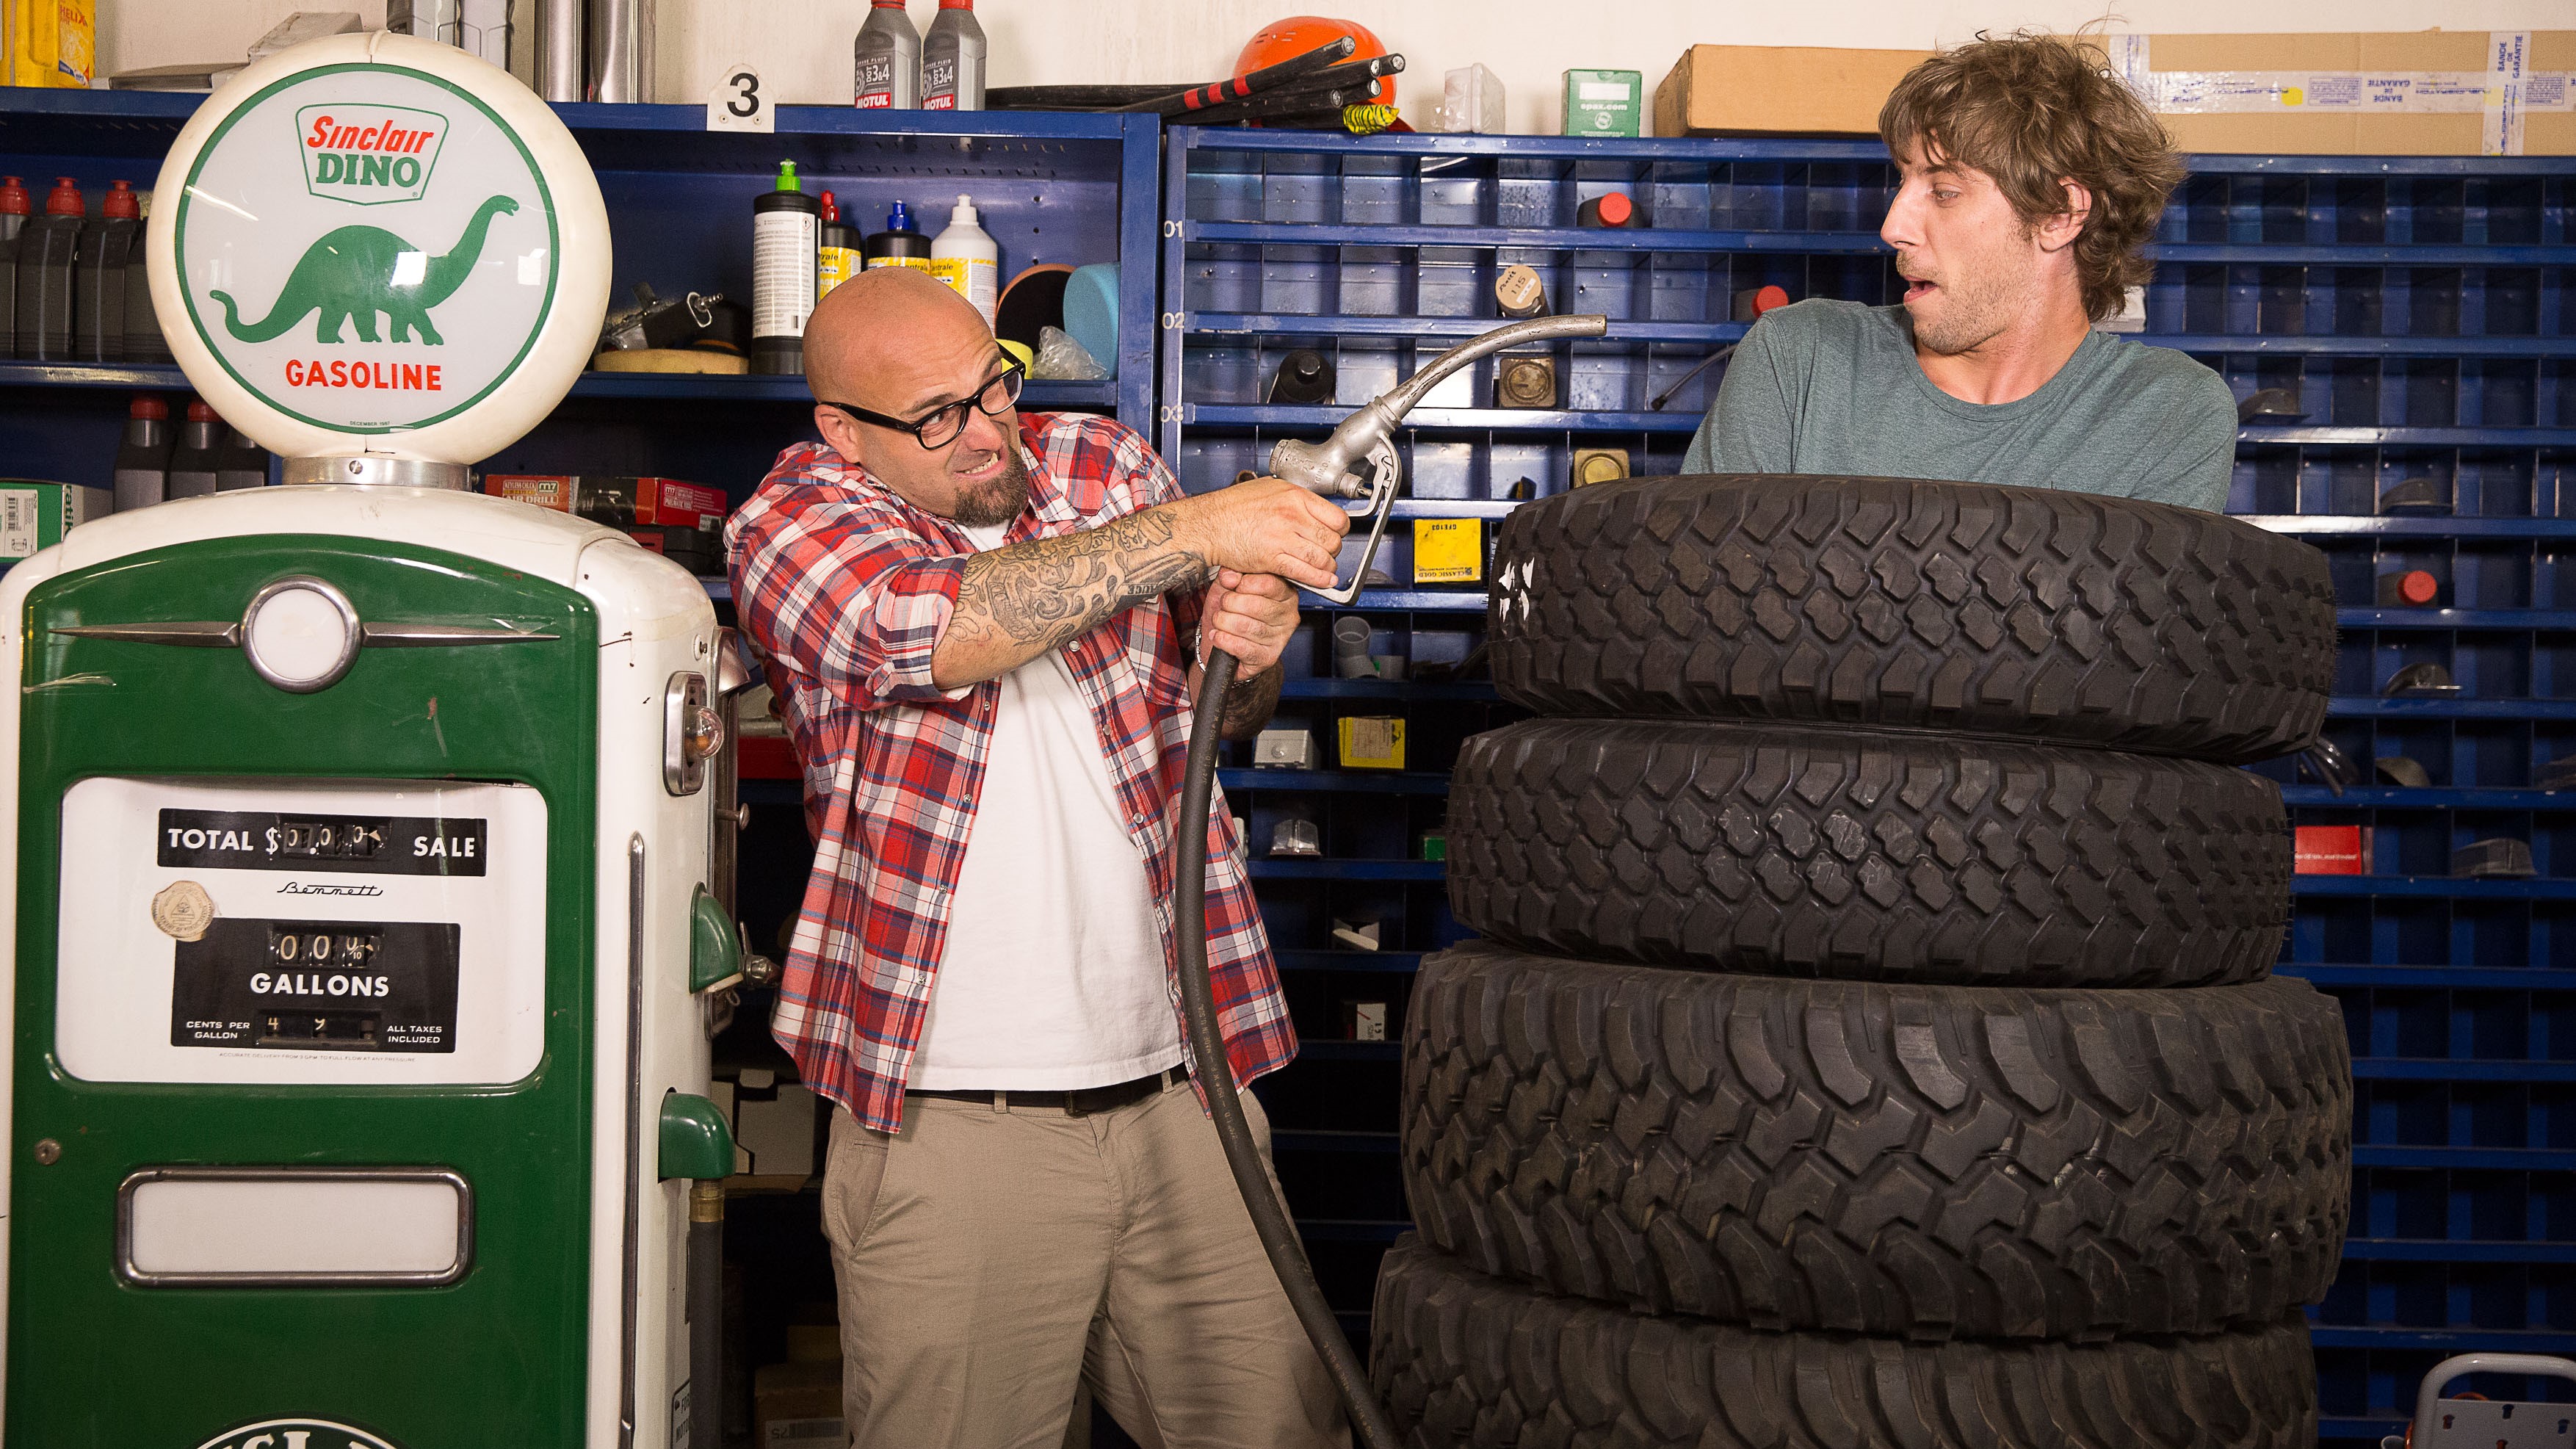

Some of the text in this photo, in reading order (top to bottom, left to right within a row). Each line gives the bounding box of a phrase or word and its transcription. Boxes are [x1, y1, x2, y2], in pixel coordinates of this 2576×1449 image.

[872, 63, 890, 82] 3&4
[938, 65, 953, 86] 3&4
[727, 73, 759, 118] 3
[856, 94, 889, 109] MOTUL
[923, 96, 952, 110] MOTUL
[307, 115, 434, 153] Sinclair
[316, 153, 421, 188] DINO
[1163, 220, 1184, 239] 01
[1511, 275, 1526, 295] 115
[1162, 312, 1185, 330] 02
[286, 359, 442, 391] GASOLINE
[1160, 405, 1184, 423] 03
[526, 495, 557, 504] DRILL
[167, 828, 254, 852] TOTAL
[265, 826, 279, 855] $
[413, 836, 475, 859] SALE
[277, 881, 383, 897] Bennett
[250, 972, 389, 997] GALLONS
[187, 1021, 251, 1030] CENTS PER
[387, 1025, 443, 1034] ALL TAXES
[194, 1031, 238, 1040] GALLON
[388, 1035, 441, 1044] INCLUDED
